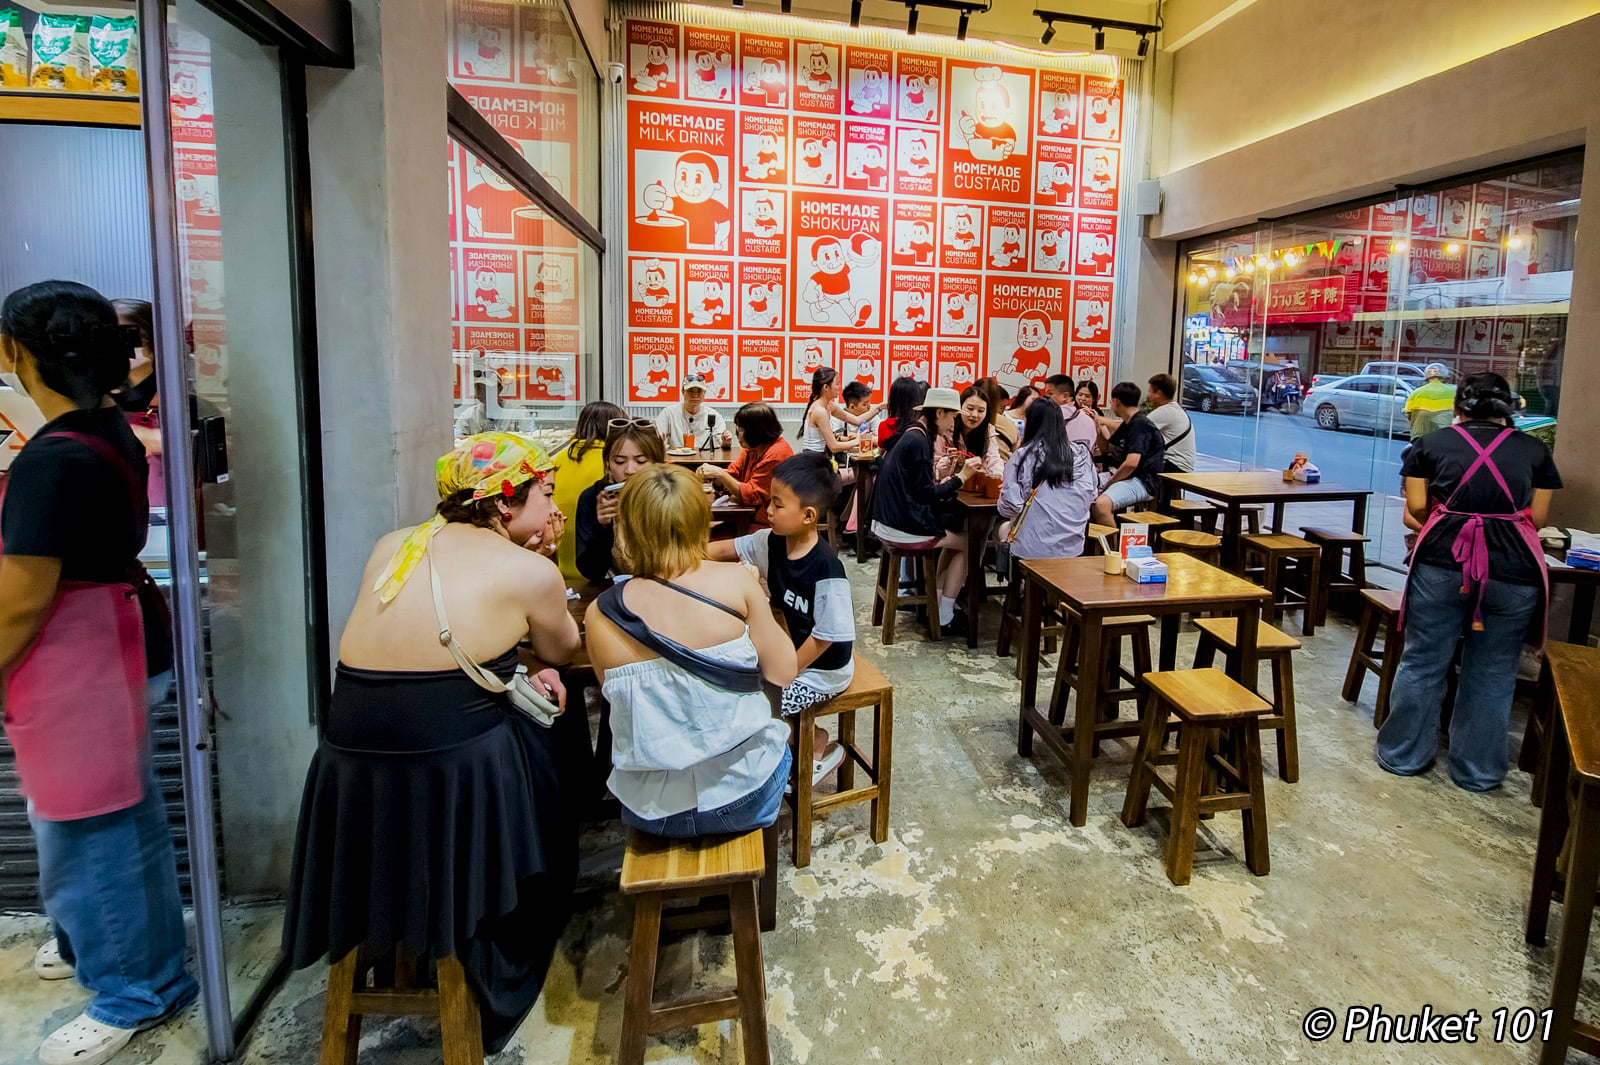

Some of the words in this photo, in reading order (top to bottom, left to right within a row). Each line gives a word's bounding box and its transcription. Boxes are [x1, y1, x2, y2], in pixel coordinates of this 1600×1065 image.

[631, 24, 674, 36] HOMEMADE
[631, 33, 674, 44] SHOKUPAN
[689, 31, 730, 42] HOMEMADE
[689, 39, 731, 50] SHOKUPAN
[745, 38, 783, 48] HOMEMADE
[745, 46, 761, 54] MILK
[762, 47, 783, 55] DRINK
[851, 50, 888, 61] HOMEMADE
[850, 57, 888, 68] SHOKUPAN
[902, 57, 937, 68] HOMEMADE
[902, 65, 938, 75] SHOKUPAN
[1044, 74, 1076, 84] HOMEMADE
[1043, 81, 1076, 91] SHOKUPAN
[800, 92, 835, 101] HOMEMADE
[800, 99, 835, 109] CUSTARD
[640, 111, 725, 131] HOMEMADE
[744, 115, 783, 126] HOMEMADE
[798, 120, 835, 130] HOMEMADE
[744, 123, 784, 133] SHOKUPAN
[850, 125, 885, 135] HOMEMADE
[640, 127, 675, 142] MILK
[680, 131, 725, 146] DRINK
[798, 128, 836, 138] SHOKUPAN
[1041, 144, 1072, 153] HOMEMADE
[1055, 152, 1072, 160] DRINK
[954, 161, 1021, 178] HOMEMADE
[900, 176, 932, 184] HOMEMADE
[955, 175, 1020, 193] CUSTARD
[900, 182, 932, 192] CUSTARD
[1084, 191, 1113, 200] HOMEMADE
[1084, 197, 1113, 207] CUSTARD
[801, 201, 880, 219] HOMEMADE
[897, 204, 932, 212] HOMEMADE
[992, 210, 1025, 219] HOMEMADE
[1038, 213, 1070, 222] HOMEMADE
[801, 216, 880, 233] SHOKUPAN
[992, 217, 1025, 225] SHOKUPAN
[1037, 220, 1070, 228] SHOKUPAN
[1081, 216, 1112, 225] HOMEMADE
[745, 238, 780, 246] HOMEMADE
[745, 245, 780, 253] CUSTARD
[946, 250, 977, 258] HOMEMADE
[946, 256, 977, 265] CUSTARD
[689, 263, 728, 271] HOMEMADE
[743, 266, 781, 274] HOMEMADE
[689, 270, 729, 279] SHOKUPAN
[743, 273, 782, 281] SHOKUPAN
[895, 274, 930, 282] HOMEMADE
[895, 280, 930, 288] SHOKUPAN
[943, 276, 977, 285] HOMEMADE
[943, 283, 977, 291] SHOKUPAN
[993, 284, 1062, 299] HOMEMADE
[1077, 290, 1109, 298] SHOKUPAN
[993, 298, 1062, 312] SHOKUPAN
[635, 308, 673, 316] HOMEMADE
[636, 314, 673, 323] CUSTARD
[634, 336, 674, 344] HOMEMADE
[689, 338, 728, 346] HOMEMADE
[743, 339, 780, 347] HOMEMADE
[634, 342, 675, 351] SHOKUPAN
[689, 344, 729, 353] SHOKUPAN
[844, 342, 880, 350] HOMEMADE
[893, 344, 928, 352] HOMEMADE
[941, 345, 974, 353] HOMEMADE
[844, 348, 881, 356] SHOKUPAN
[893, 350, 928, 359] SHOKUPAN
[1074, 356, 1106, 364] SHOKUPAN
[783, 589, 809, 614] EN
